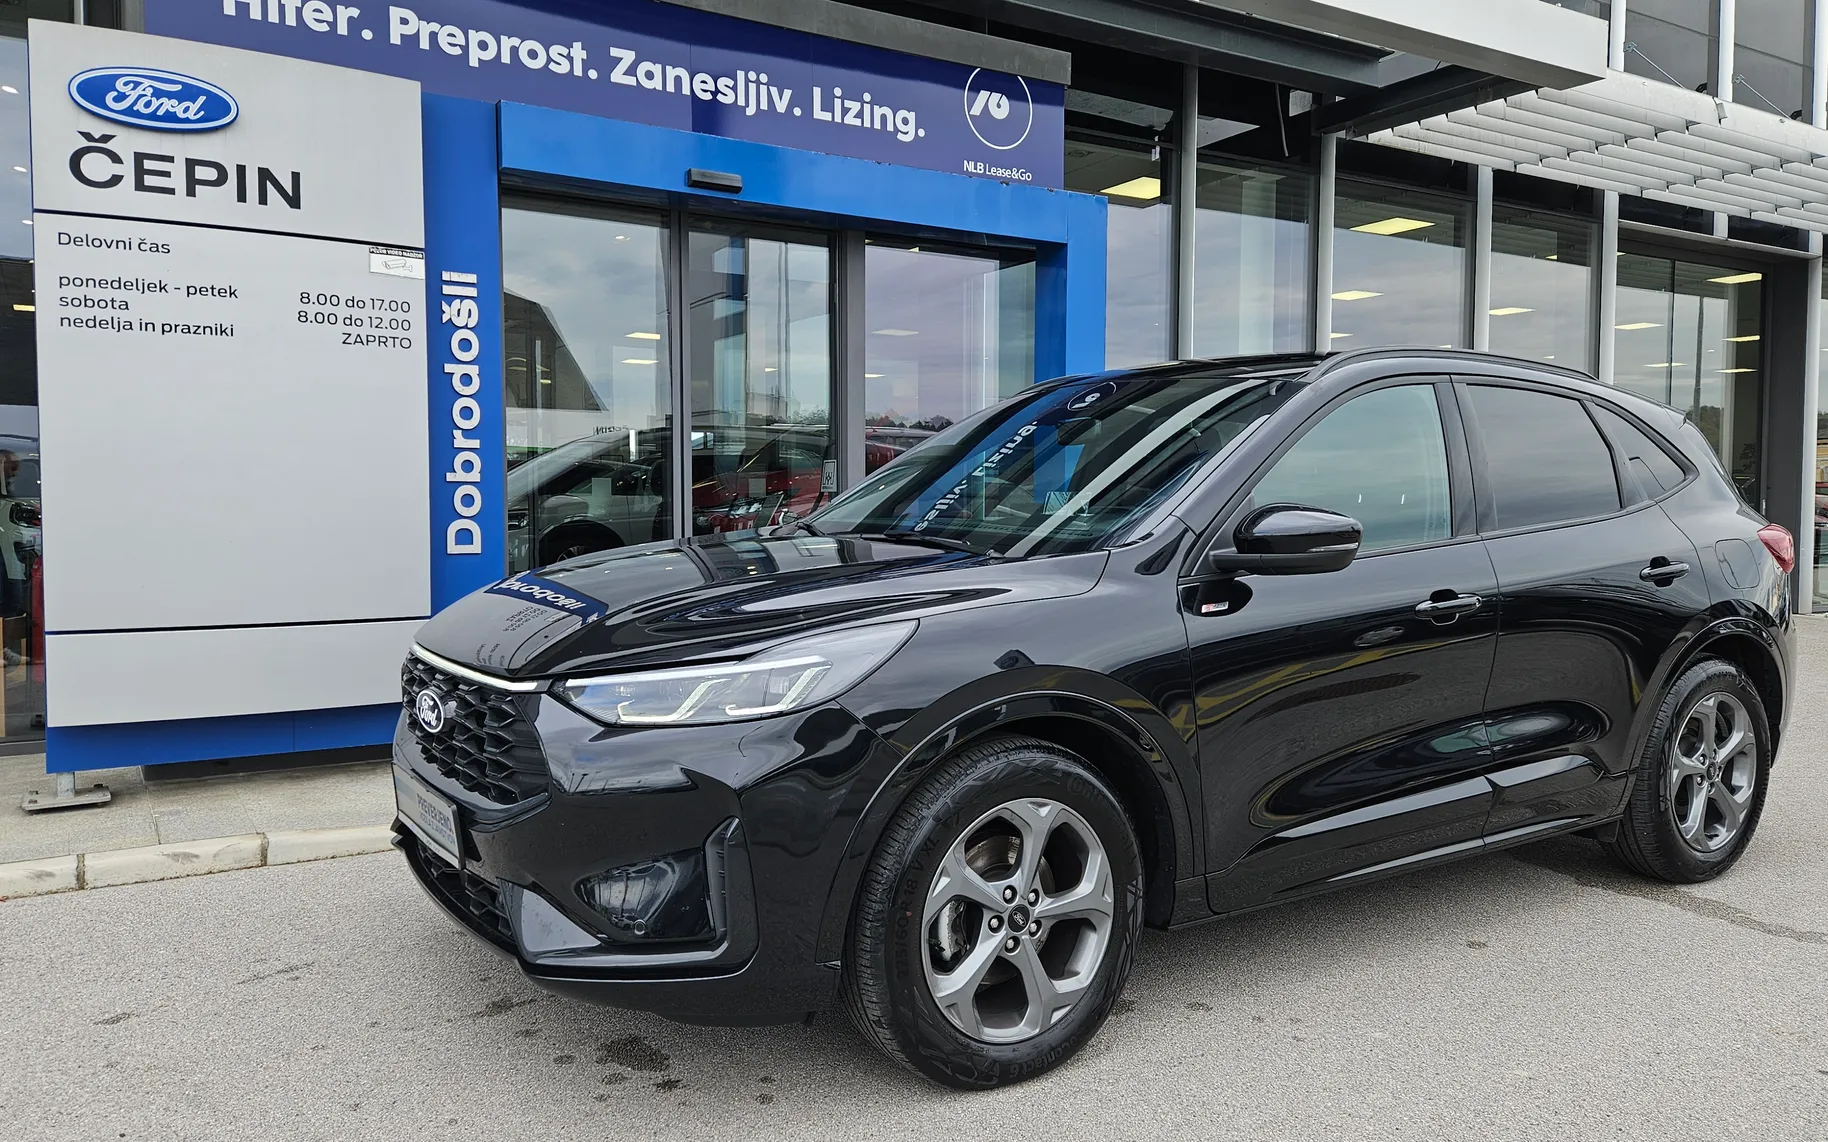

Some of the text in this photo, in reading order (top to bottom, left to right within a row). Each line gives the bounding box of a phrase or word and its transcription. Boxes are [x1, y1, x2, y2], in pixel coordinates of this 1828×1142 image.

[389, 5, 598, 79] Preprost.
[608, 46, 802, 117] Zanesljiv.
[812, 86, 926, 143] Lizing.
[105, 75, 206, 120] Ford
[68, 129, 301, 210] ČEPIN
[963, 159, 1033, 181] NLB Lease&Go
[57, 231, 171, 254] Delovni čas
[58, 275, 169, 295] ponedeljek
[186, 284, 239, 299] petek
[59, 294, 130, 311] sobota
[299, 291, 411, 314] 8.00 do 17.00
[60, 315, 234, 338] nedelja in prazniki
[297, 310, 411, 332] 8.00 do 12.00
[341, 332, 412, 350] ZAPRTO
[441, 270, 482, 554] Dobrodošli
